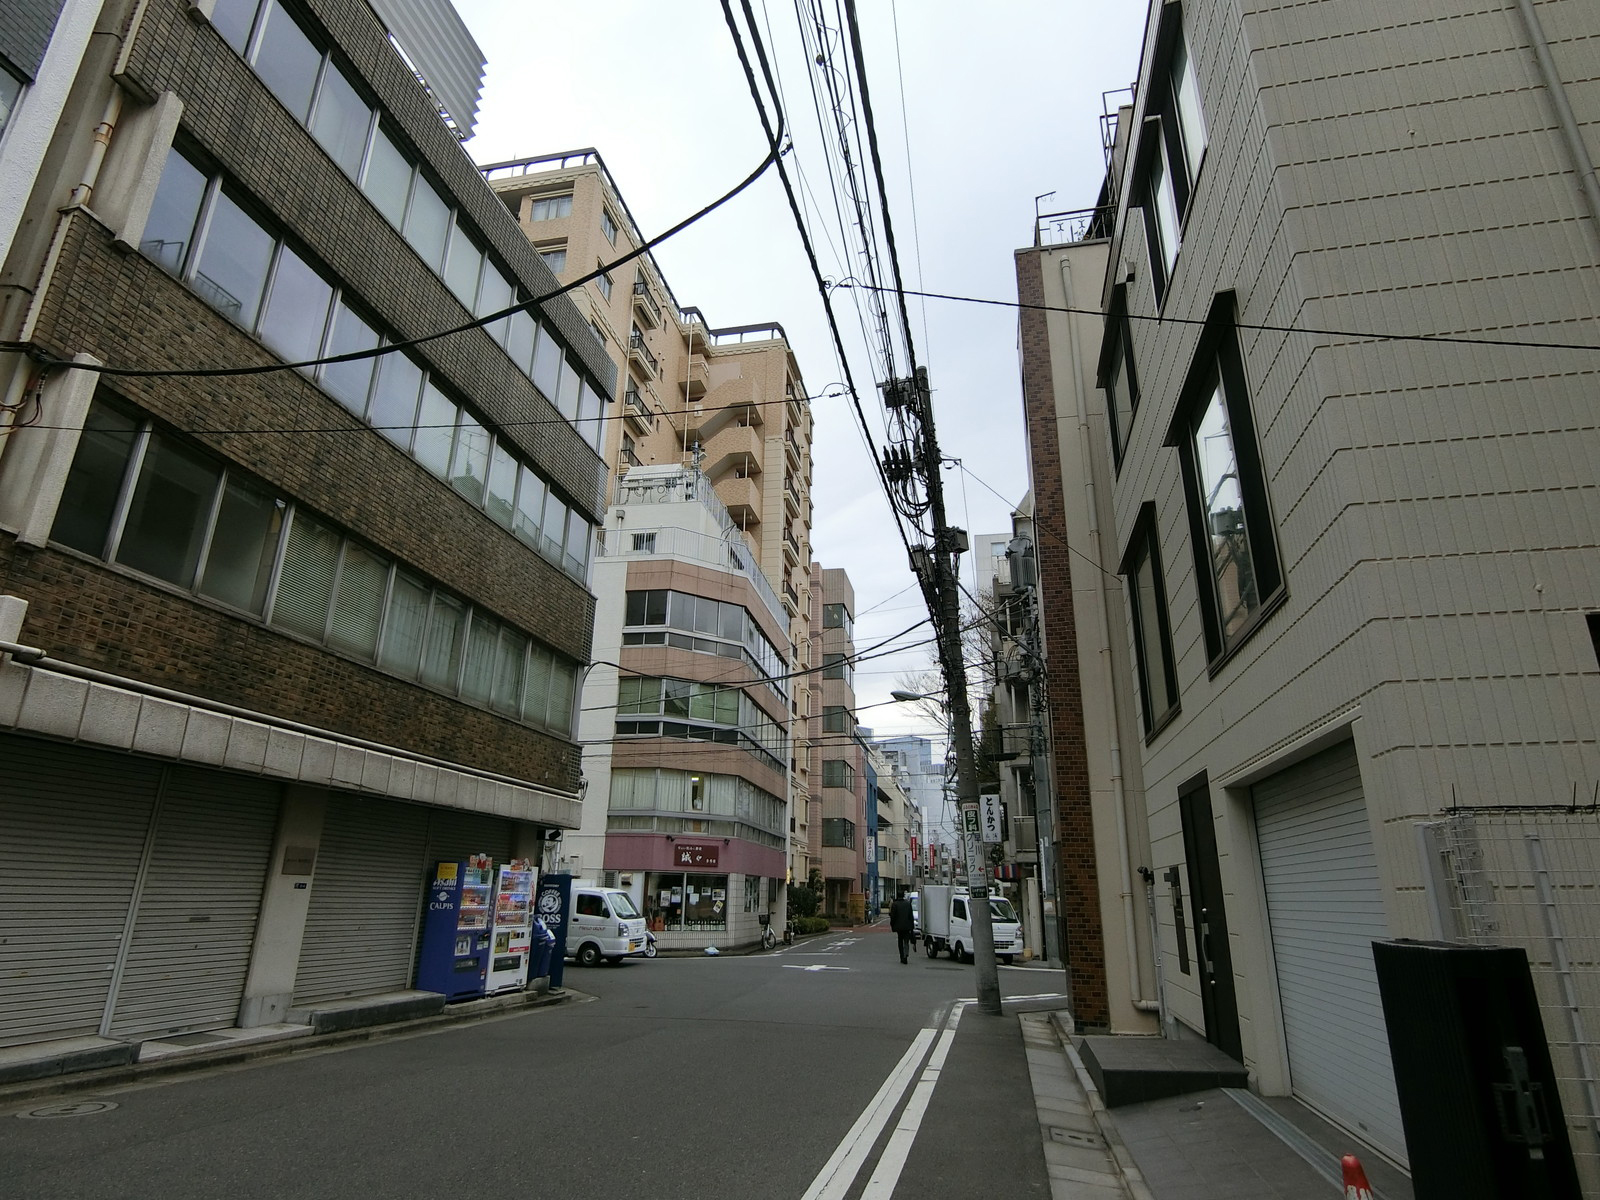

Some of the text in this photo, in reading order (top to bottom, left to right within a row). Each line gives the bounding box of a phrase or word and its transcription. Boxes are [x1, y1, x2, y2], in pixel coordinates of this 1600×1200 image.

[967, 811, 978, 831] 皮フ科
[986, 797, 996, 832] とんかつ
[966, 833, 976, 873] クリニック
[541, 889, 561, 898] COFFEE
[429, 902, 455, 910] CALPIS
